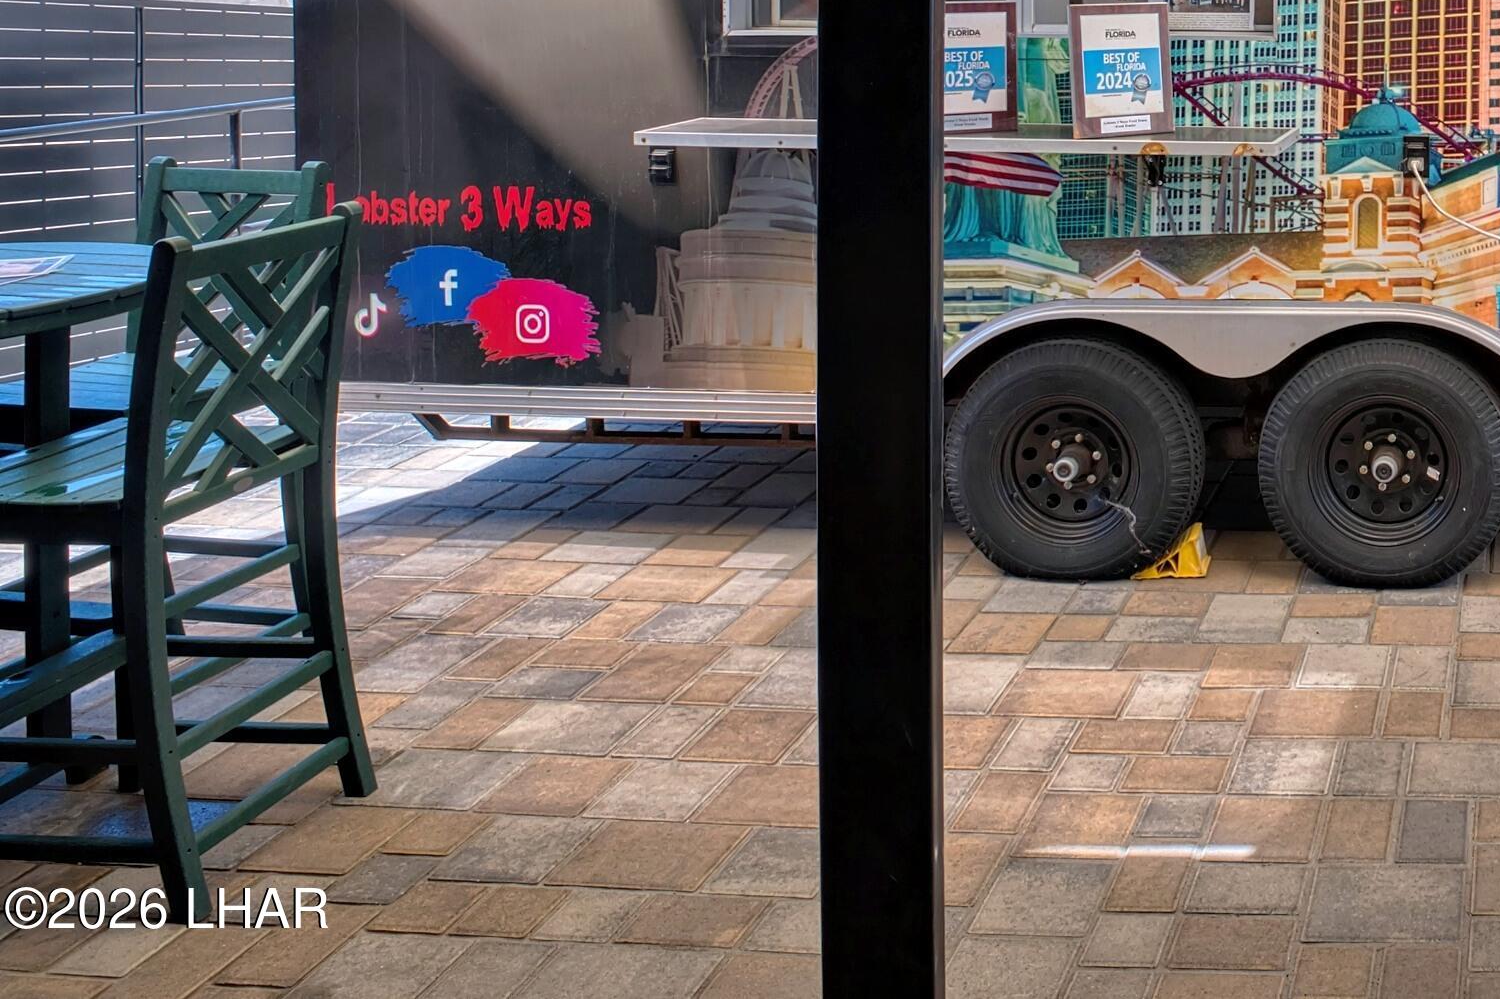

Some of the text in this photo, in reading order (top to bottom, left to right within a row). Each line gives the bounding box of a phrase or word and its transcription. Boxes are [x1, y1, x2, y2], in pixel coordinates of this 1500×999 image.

[947, 29, 981, 37] FLORIDA
[1105, 30, 1136, 38] FLORIDA
[944, 51, 984, 62] BEST OF
[1103, 52, 1140, 64] BEST OF
[958, 61, 990, 70] FLORIDA
[1116, 62, 1146, 72] FLORIDA
[944, 70, 974, 88] 025
[1096, 72, 1133, 90] 2024
[460, 185, 484, 232] 3
[493, 185, 592, 232] Ways
